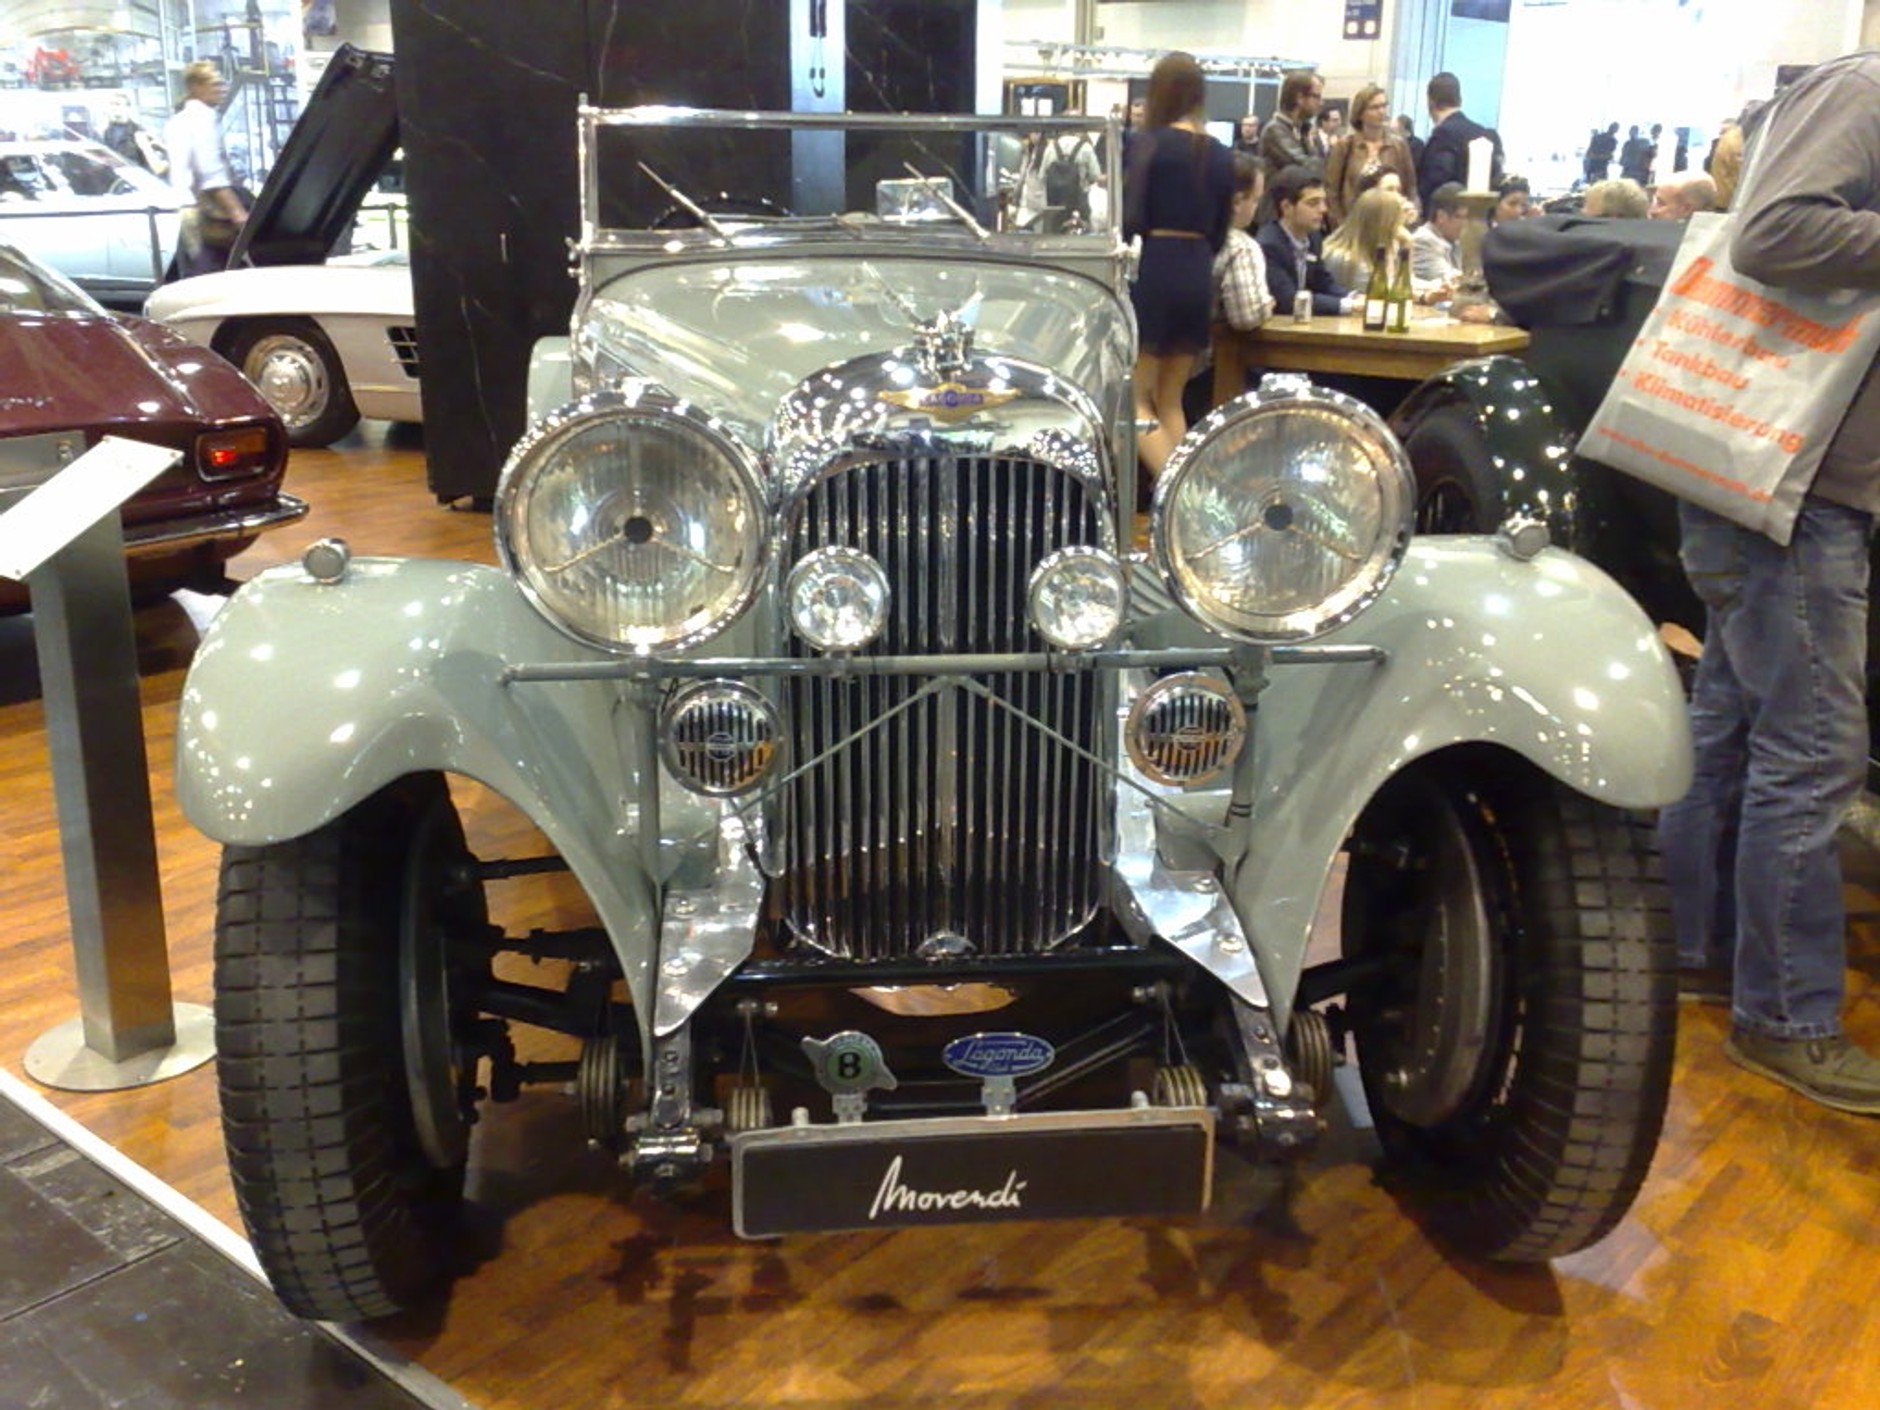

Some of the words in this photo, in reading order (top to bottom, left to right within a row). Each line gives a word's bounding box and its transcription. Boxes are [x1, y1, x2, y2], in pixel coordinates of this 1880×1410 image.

[1652, 341, 1748, 390] Tankbau
[952, 1040, 1046, 1070] Lagonda
[868, 1154, 1028, 1220] Movendi
